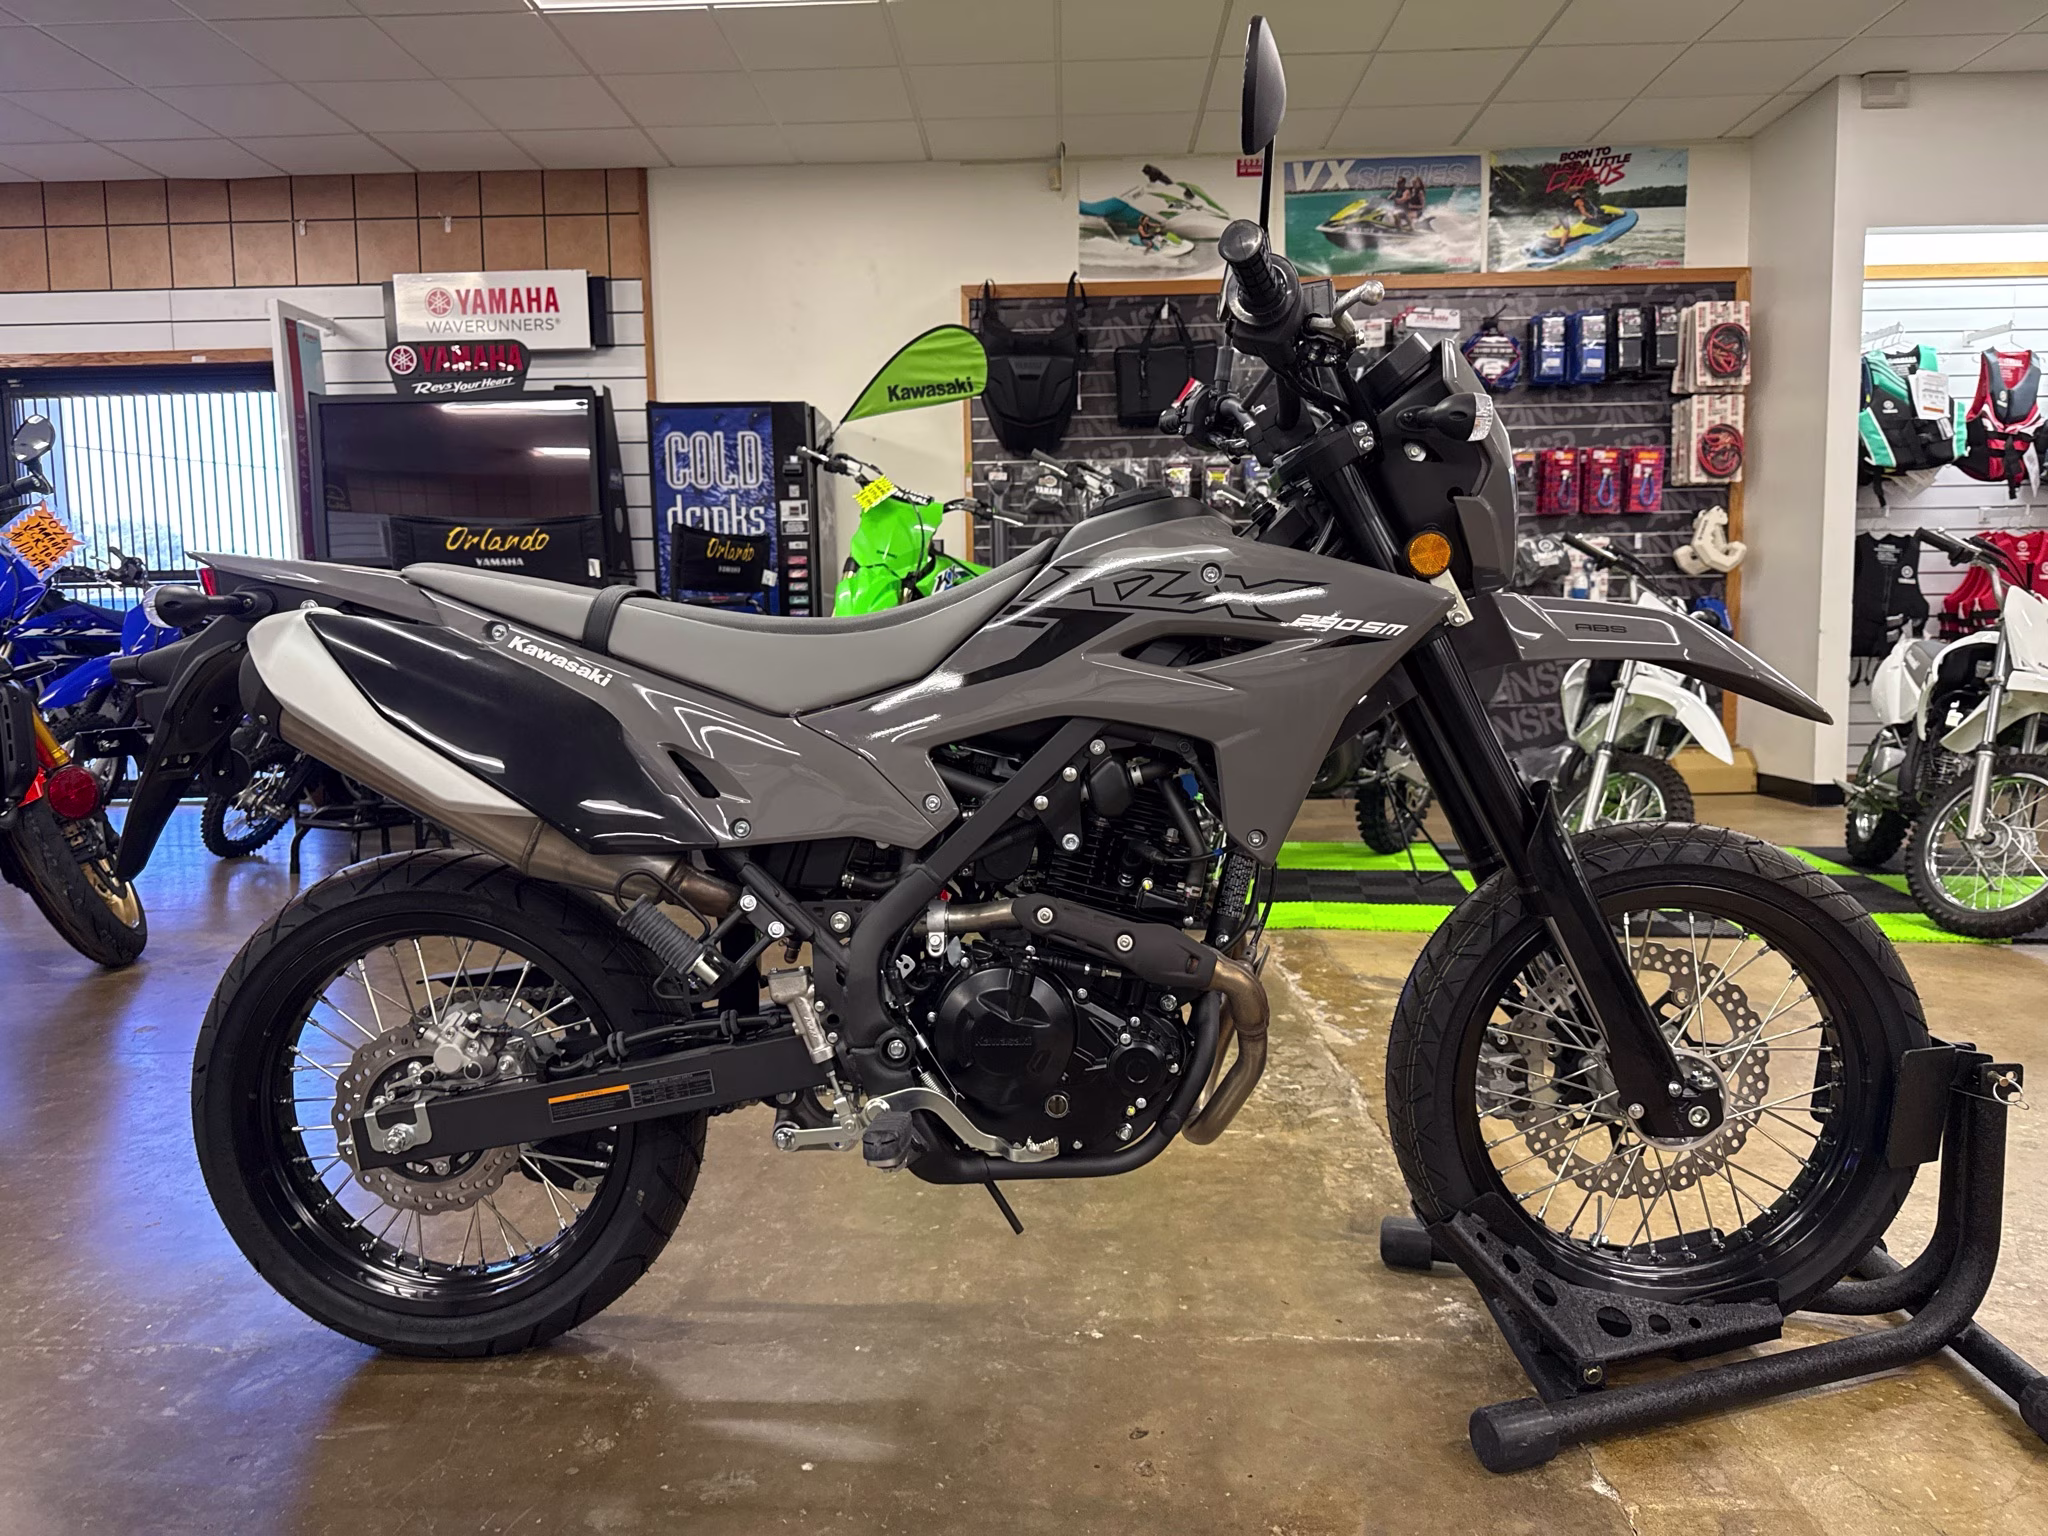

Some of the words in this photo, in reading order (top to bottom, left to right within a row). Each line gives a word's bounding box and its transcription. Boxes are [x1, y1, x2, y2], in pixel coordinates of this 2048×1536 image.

[1559, 148, 1593, 161] BORN
[1595, 146, 1611, 157] TO
[1592, 153, 1632, 167] LITTLE
[1292, 160, 1356, 190] VX
[1355, 163, 1467, 189] SERIES
[1545, 164, 1626, 193] CHAOS
[455, 287, 560, 315] YAMAHA
[420, 344, 524, 373] YAMAHA
[412, 381, 452, 394] Revs
[452, 380, 484, 393] Your
[482, 376, 516, 389] Heart
[887, 376, 974, 402] Kawasaki
[664, 431, 763, 489] COLD
[446, 526, 550, 551] Orlando
[706, 538, 755, 562] Orlando
[475, 557, 525, 567] YAMAHA
[1575, 623, 1628, 634] ABS
[507, 635, 613, 688] Kawasaki
